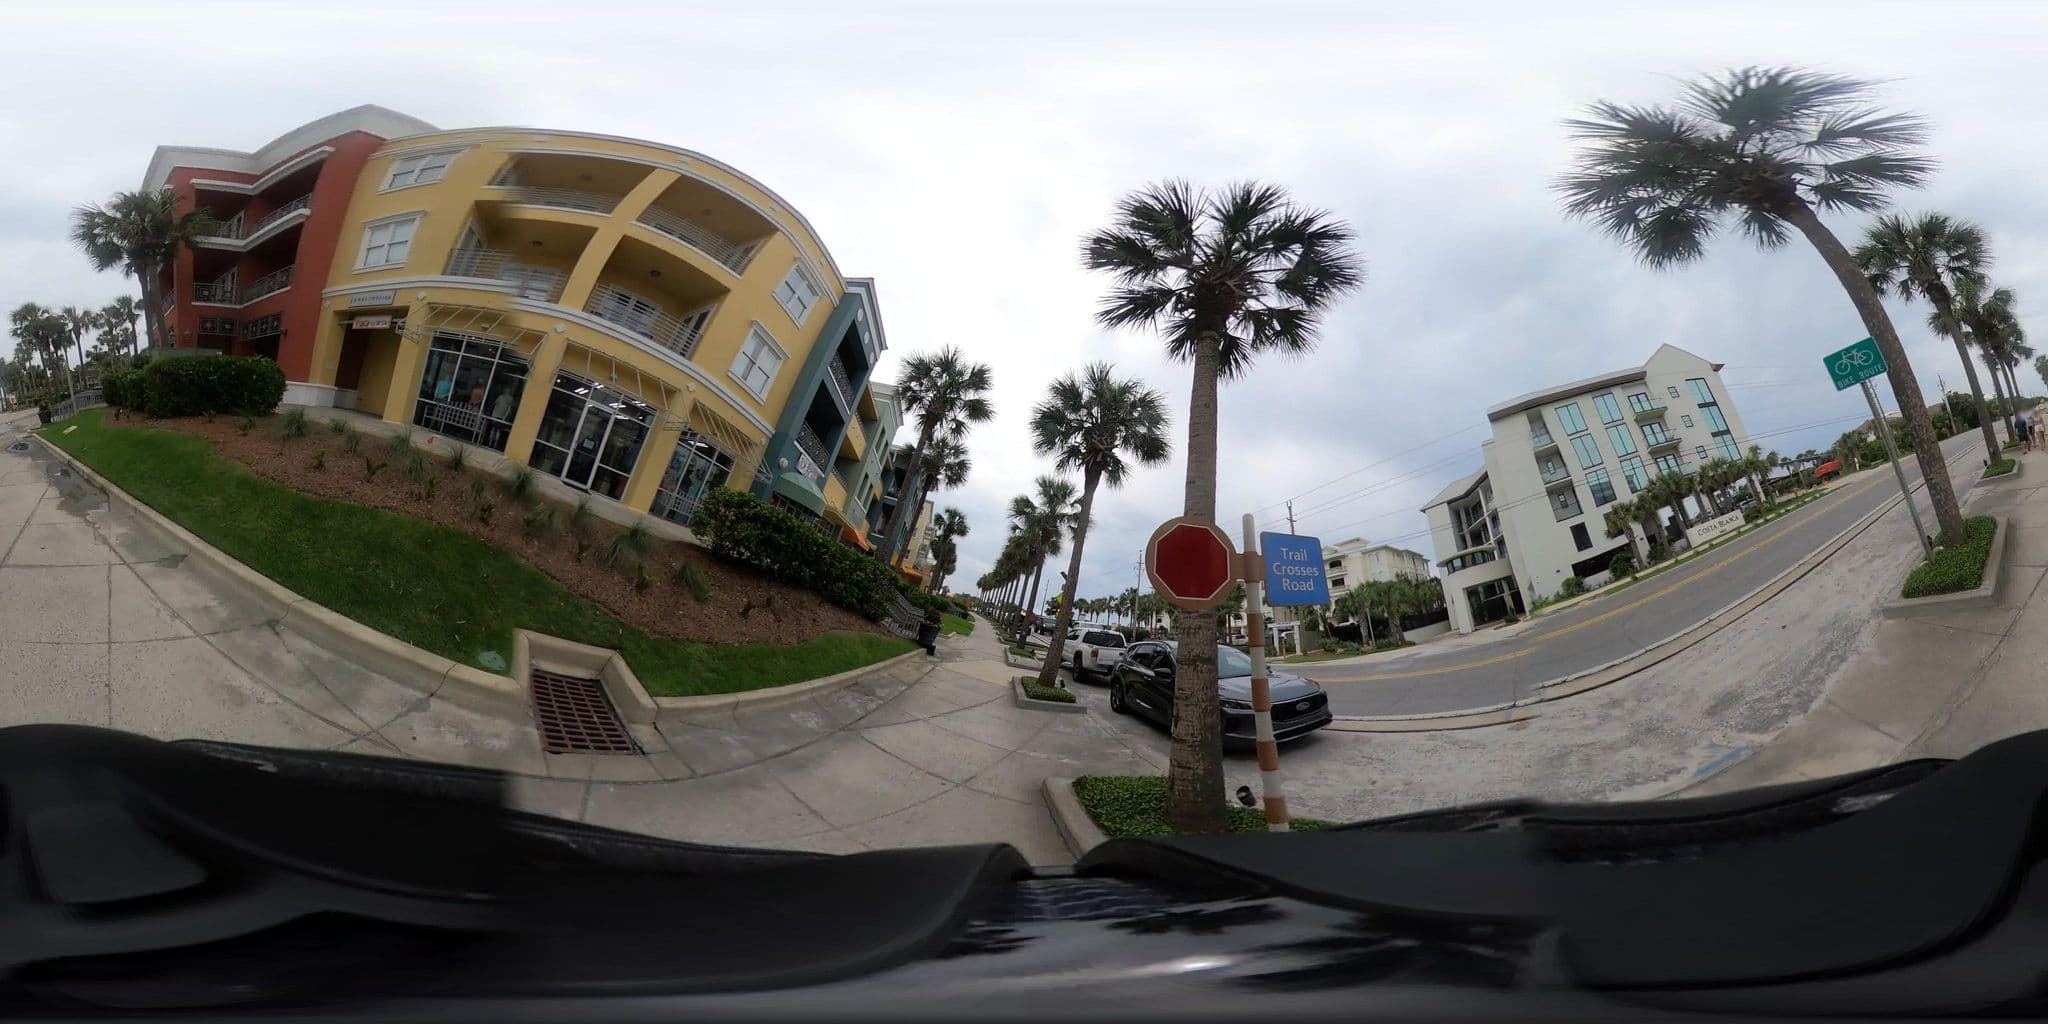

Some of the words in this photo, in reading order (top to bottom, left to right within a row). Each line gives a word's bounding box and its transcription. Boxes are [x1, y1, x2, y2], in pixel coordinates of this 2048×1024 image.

[1837, 376, 1855, 388] BIKE
[1859, 363, 1884, 380] ROUTE
[1697, 523, 1718, 536] COSTA
[1718, 514, 1740, 528] BLANCA
[1280, 547, 1308, 561] Trail
[1272, 562, 1319, 577] Crosses
[1282, 578, 1314, 592] Road
